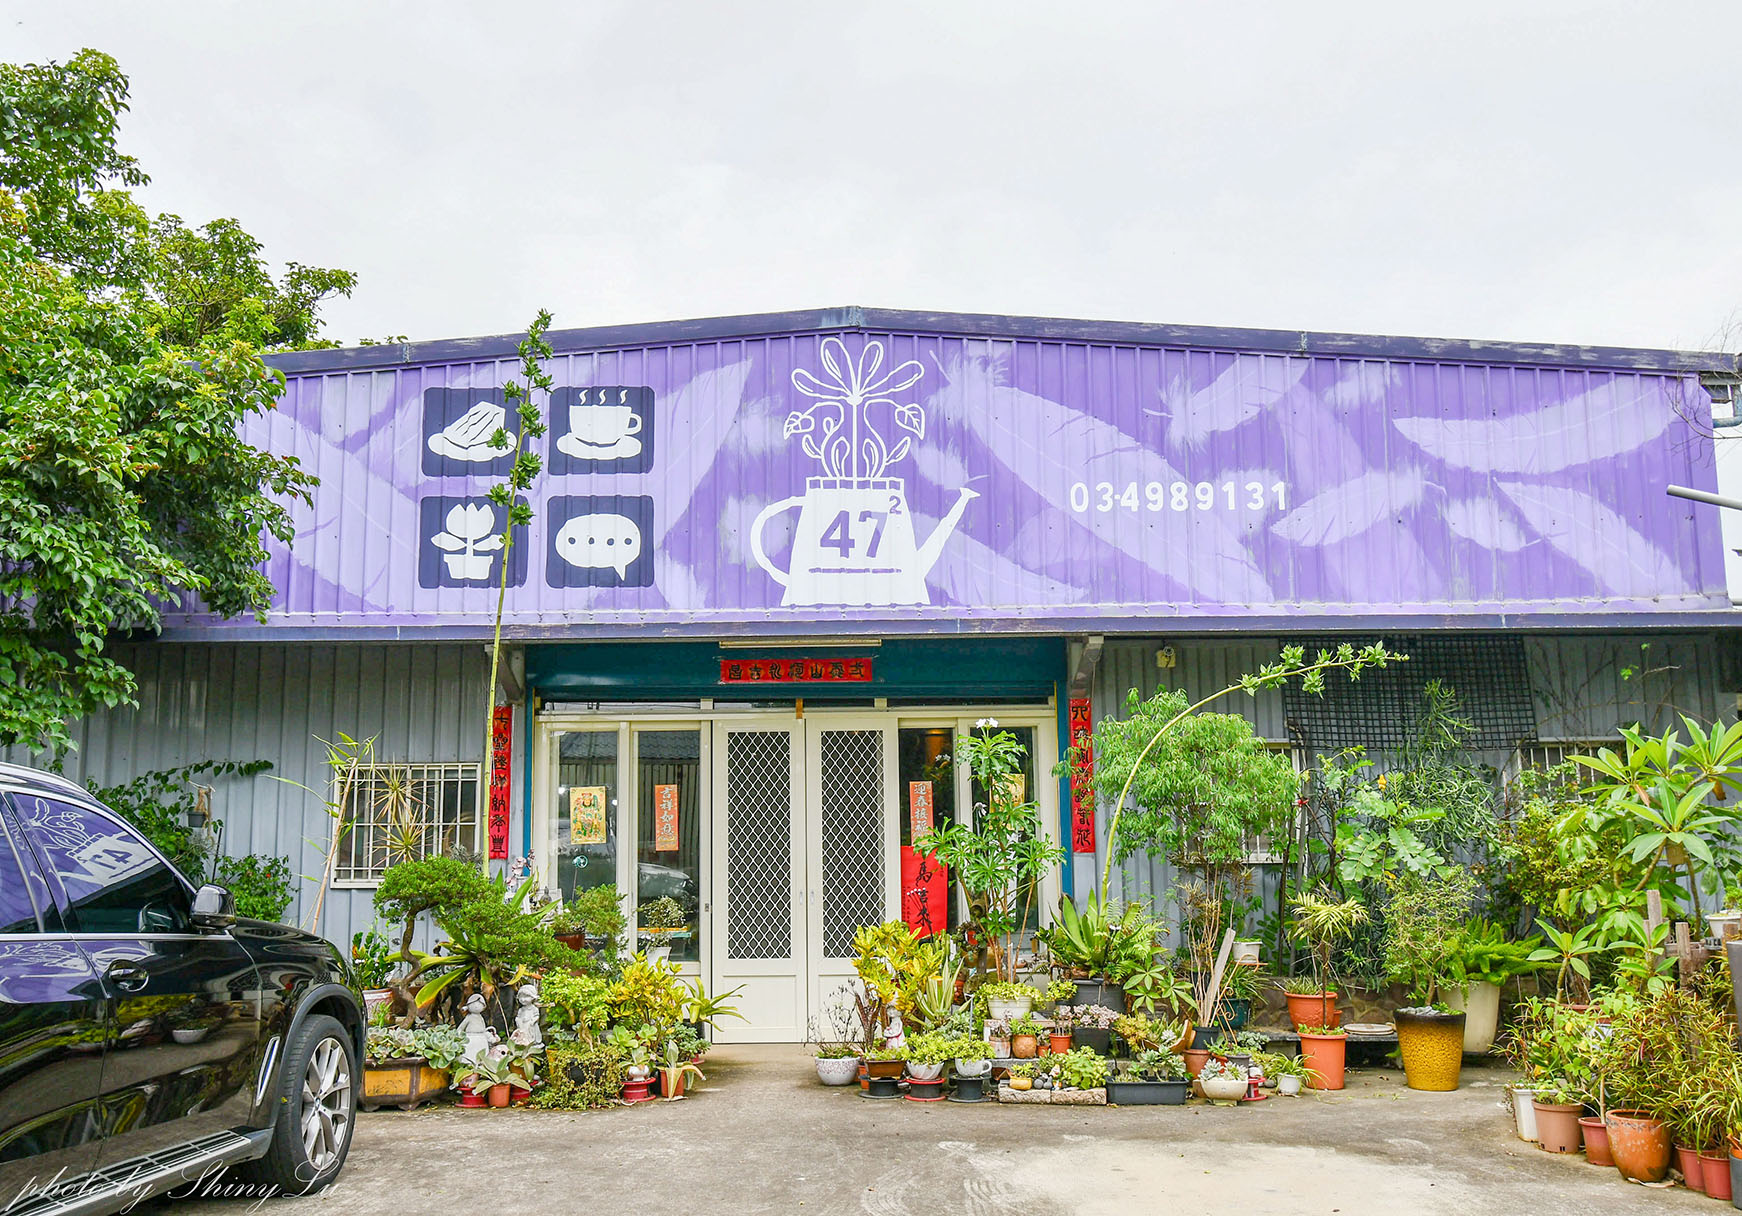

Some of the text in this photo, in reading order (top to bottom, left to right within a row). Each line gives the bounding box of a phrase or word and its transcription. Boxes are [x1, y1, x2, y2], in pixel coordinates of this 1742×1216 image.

[659, 787, 675, 835] 吉祥如意
[913, 783, 930, 832] 迎春接福
